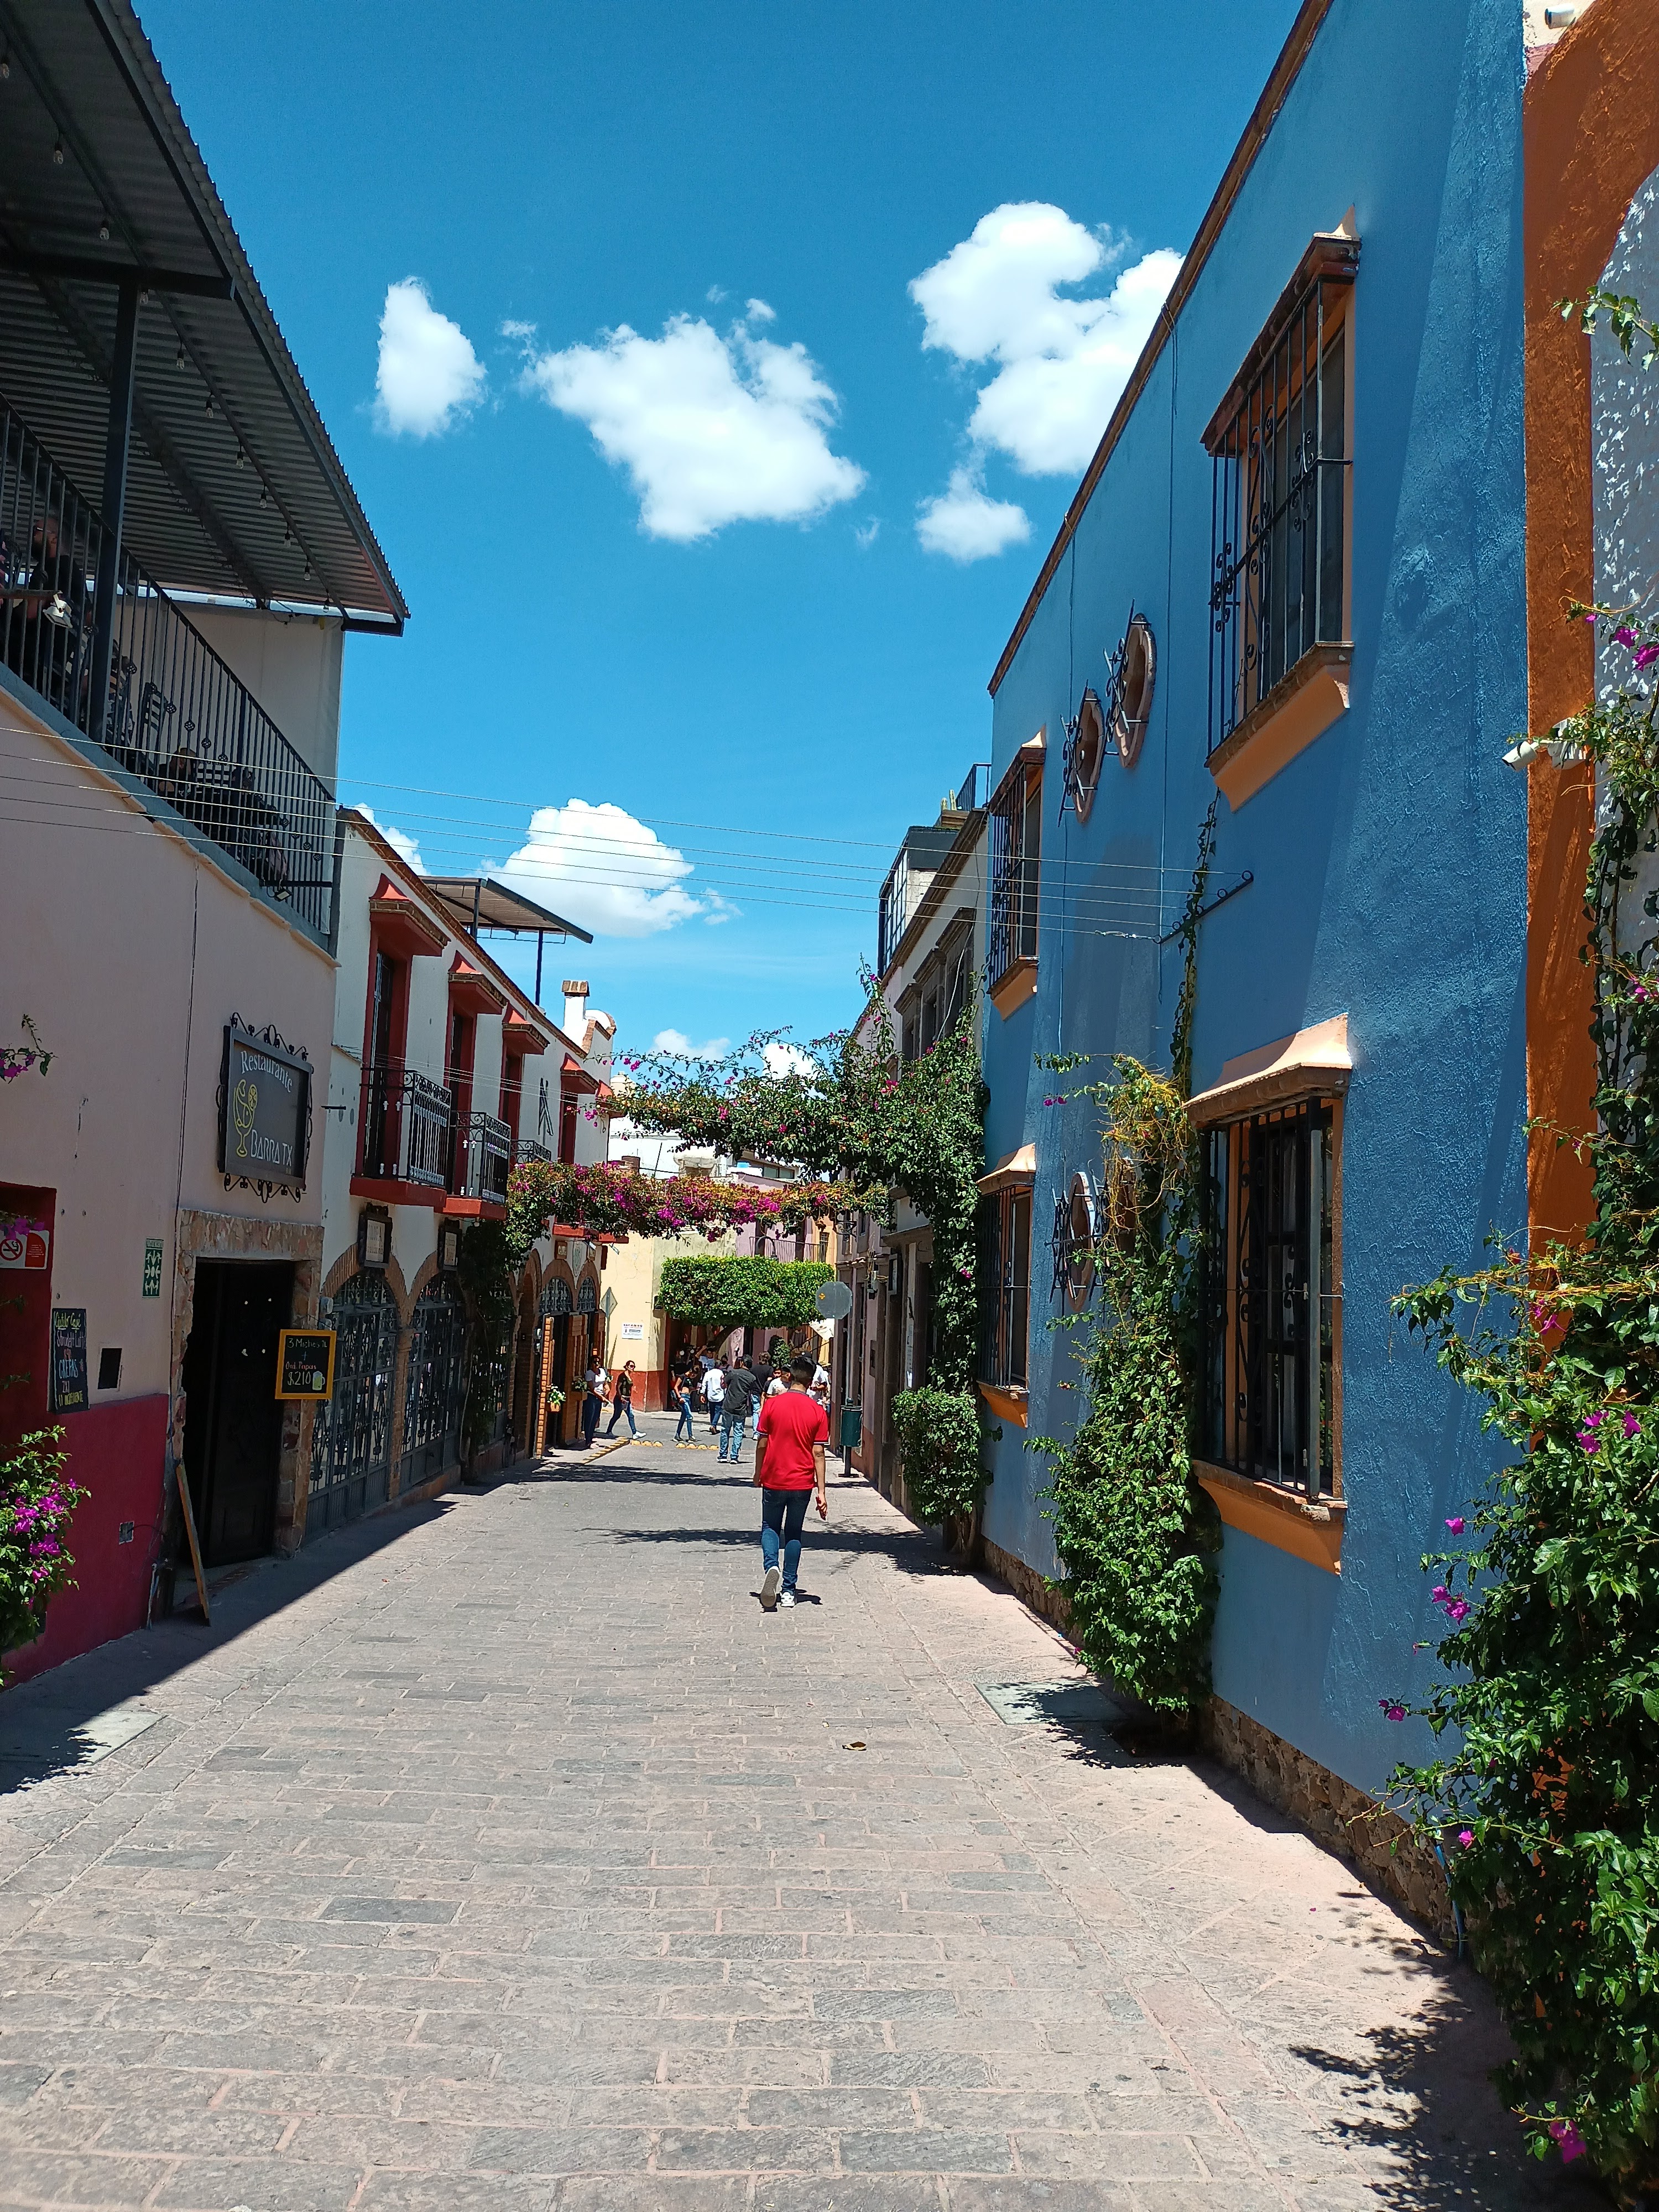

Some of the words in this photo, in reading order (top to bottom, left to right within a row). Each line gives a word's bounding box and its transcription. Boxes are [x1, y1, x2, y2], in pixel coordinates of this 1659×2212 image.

[241, 1050, 293, 1093] Restaurante
[251, 1129, 280, 1164] BARRA
[281, 1142, 293, 1167] TX
[288, 1338, 294, 1348] 3
[285, 1361, 297, 1370] Ord.
[299, 1361, 316, 1371] Papas
[288, 1371, 311, 1385] $210
